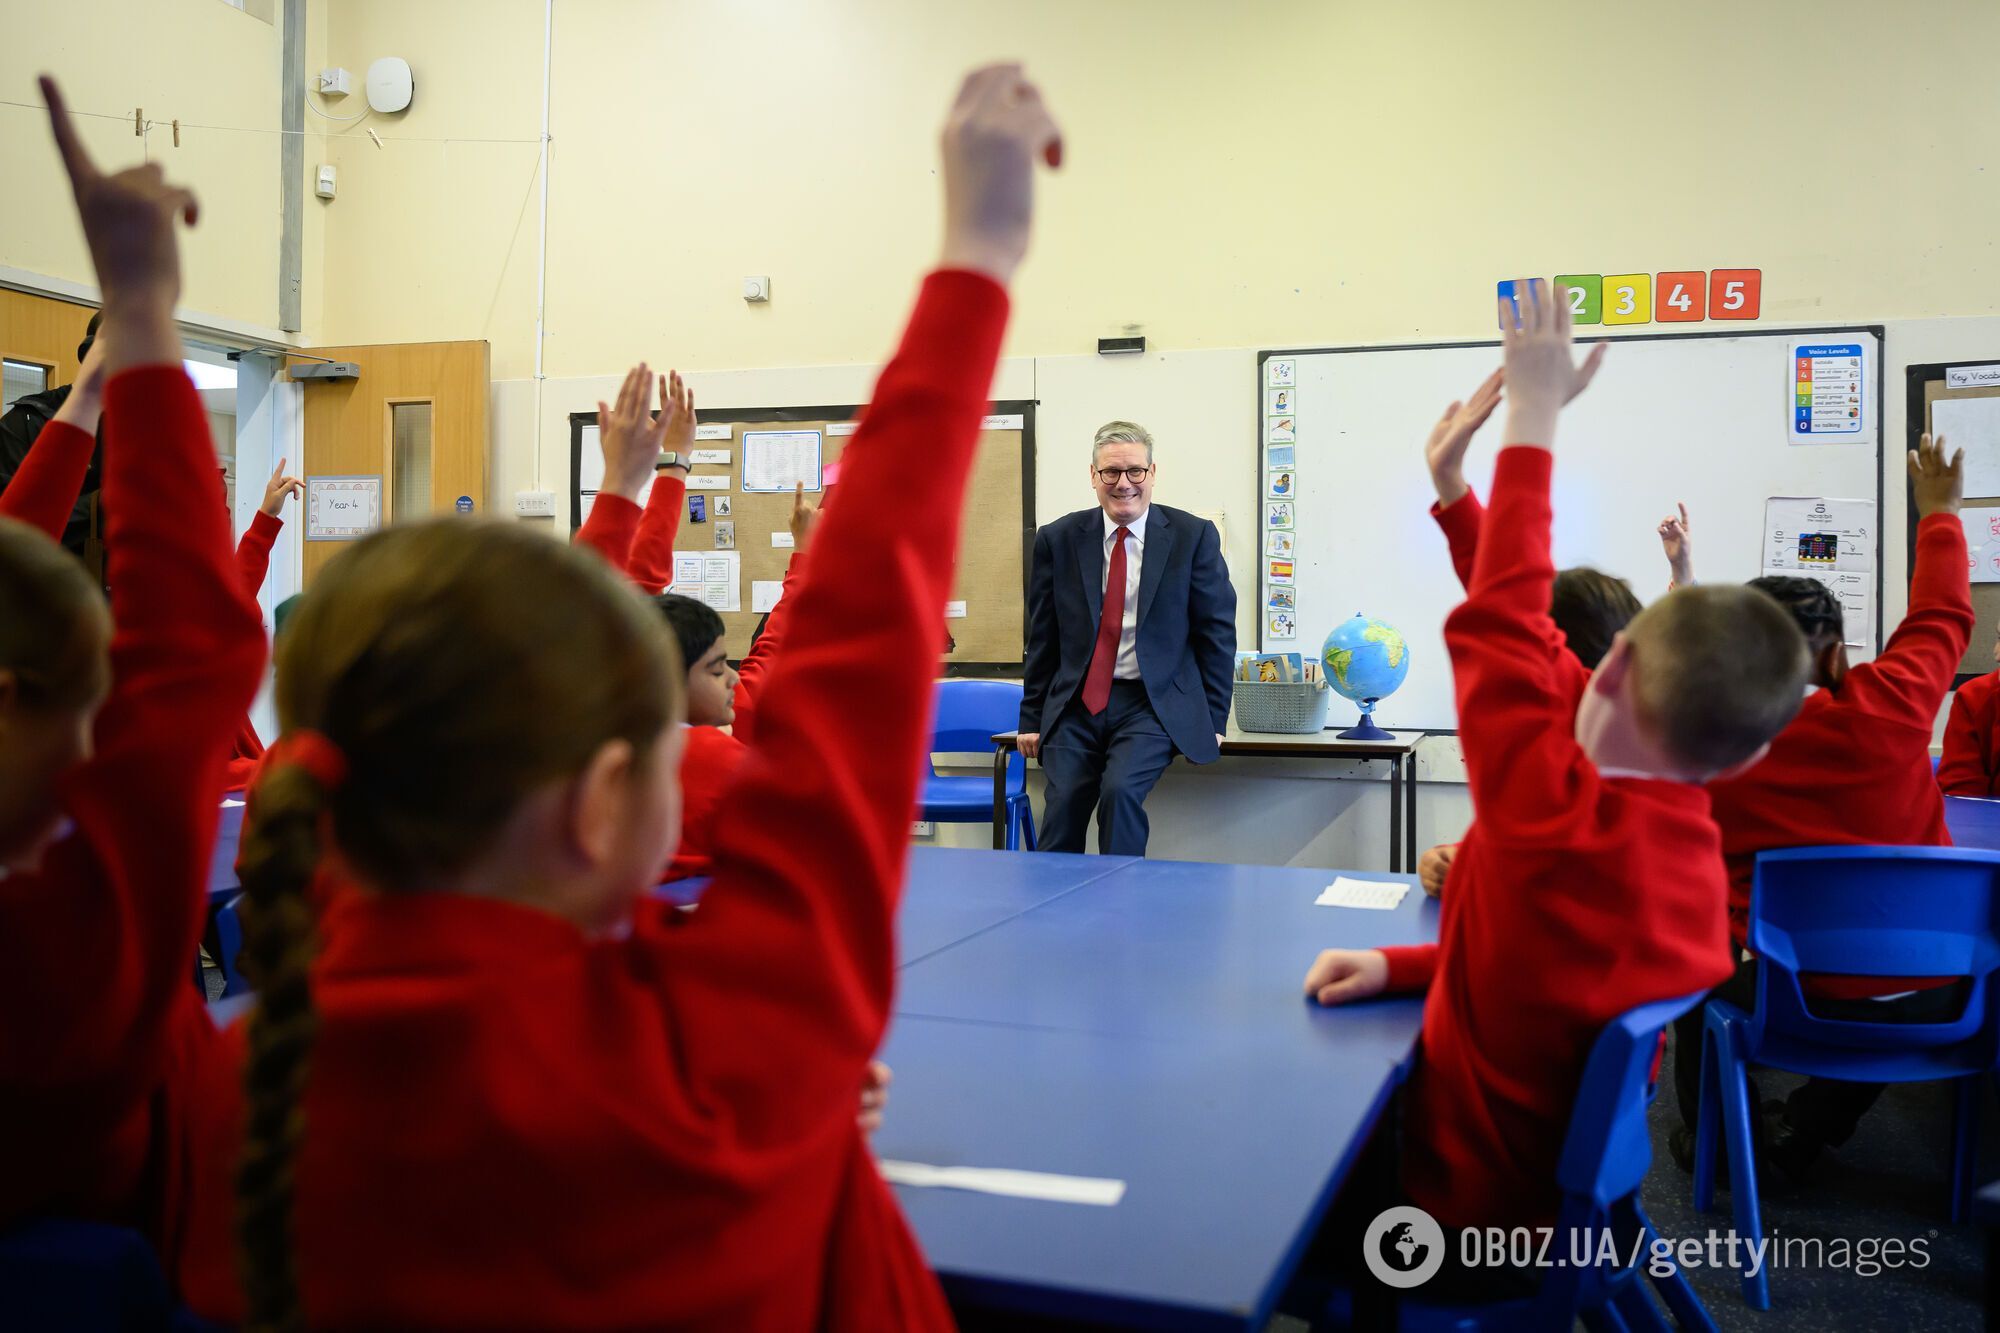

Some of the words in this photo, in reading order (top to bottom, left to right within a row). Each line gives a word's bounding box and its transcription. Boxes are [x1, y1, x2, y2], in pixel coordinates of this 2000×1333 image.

[1567, 286, 1586, 315] 2
[1615, 286, 1636, 315] 3
[1667, 284, 1692, 312] 4
[1722, 281, 1745, 310] 5
[1801, 360, 1808, 368] 5
[1800, 371, 1808, 379] 4
[1951, 373, 1968, 384] Key
[1801, 396, 1808, 405] 2
[1801, 409, 1807, 417] 1
[1800, 421, 1808, 430] 0
[329, 498, 350, 510] Year
[352, 498, 359, 509] 4
